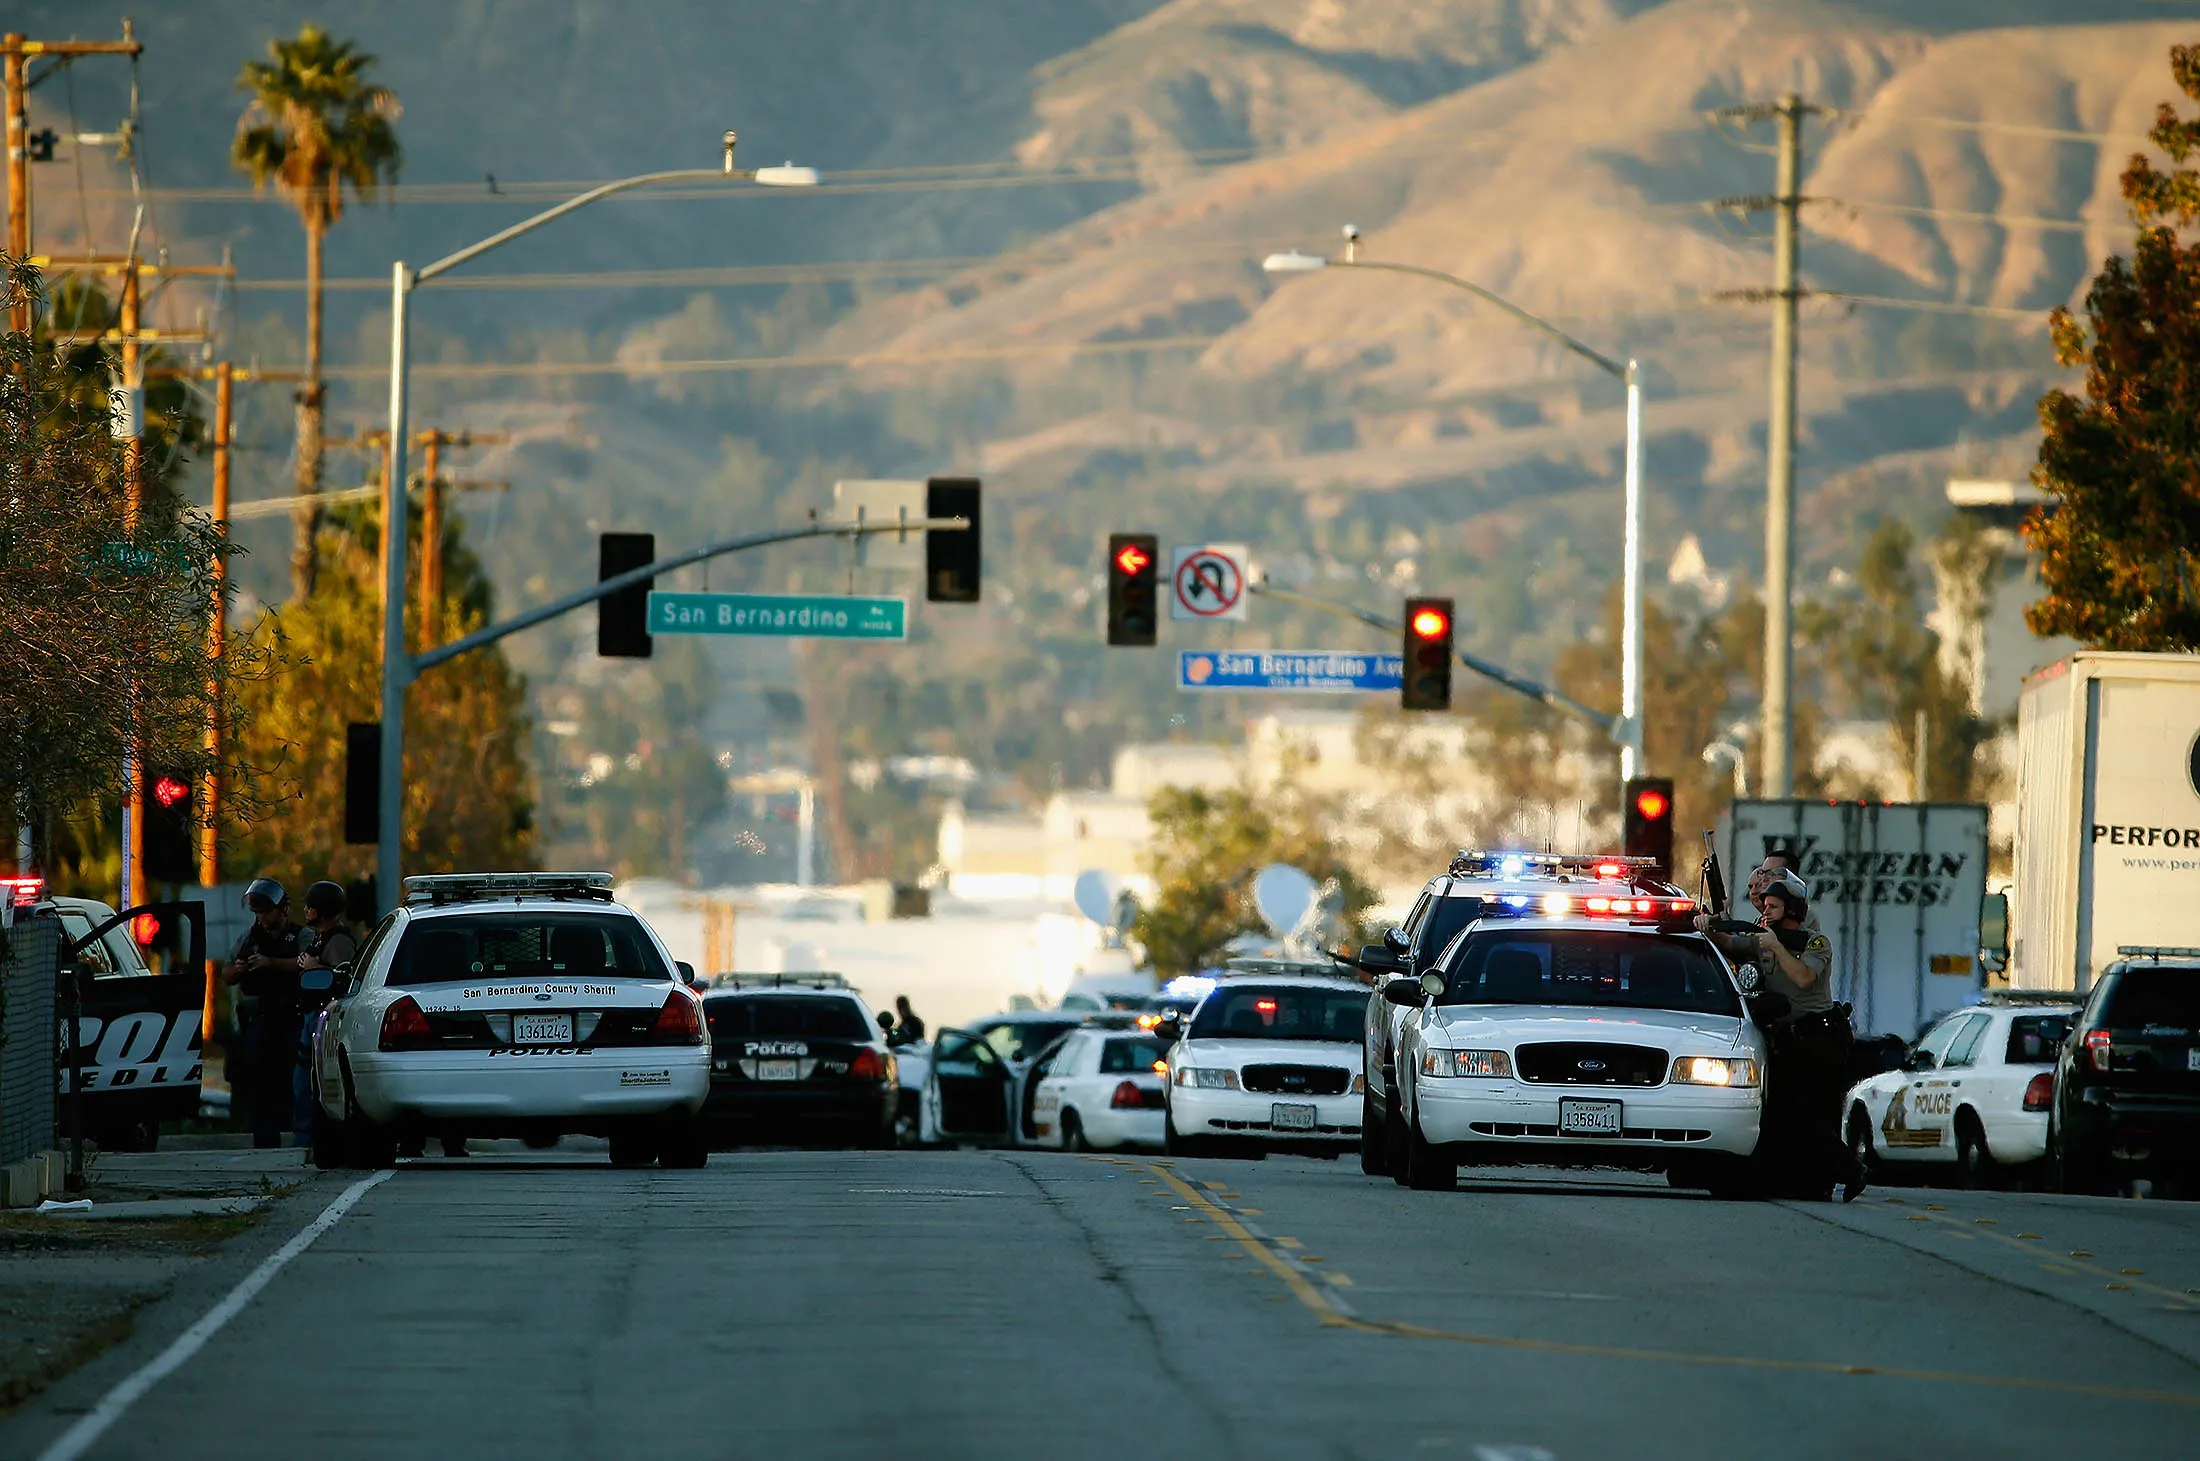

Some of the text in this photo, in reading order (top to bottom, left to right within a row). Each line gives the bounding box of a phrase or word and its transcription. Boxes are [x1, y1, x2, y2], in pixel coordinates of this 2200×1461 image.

[664, 602, 705, 623] San
[718, 604, 848, 628] Bernardino
[1217, 654, 1254, 676] San
[1260, 654, 1367, 677] Bernardino
[2092, 825, 2200, 848] PERFOR
[2122, 858, 2200, 871] www.per
[463, 984, 617, 998] San Bernardino County Sheriff
[519, 1025, 569, 1039] 1361242
[488, 1047, 594, 1057] POLICE
[62, 1064, 202, 1087] EDLA
[1915, 1093, 1951, 1113] POLICE
[1565, 1112, 1616, 1129] 1358411
